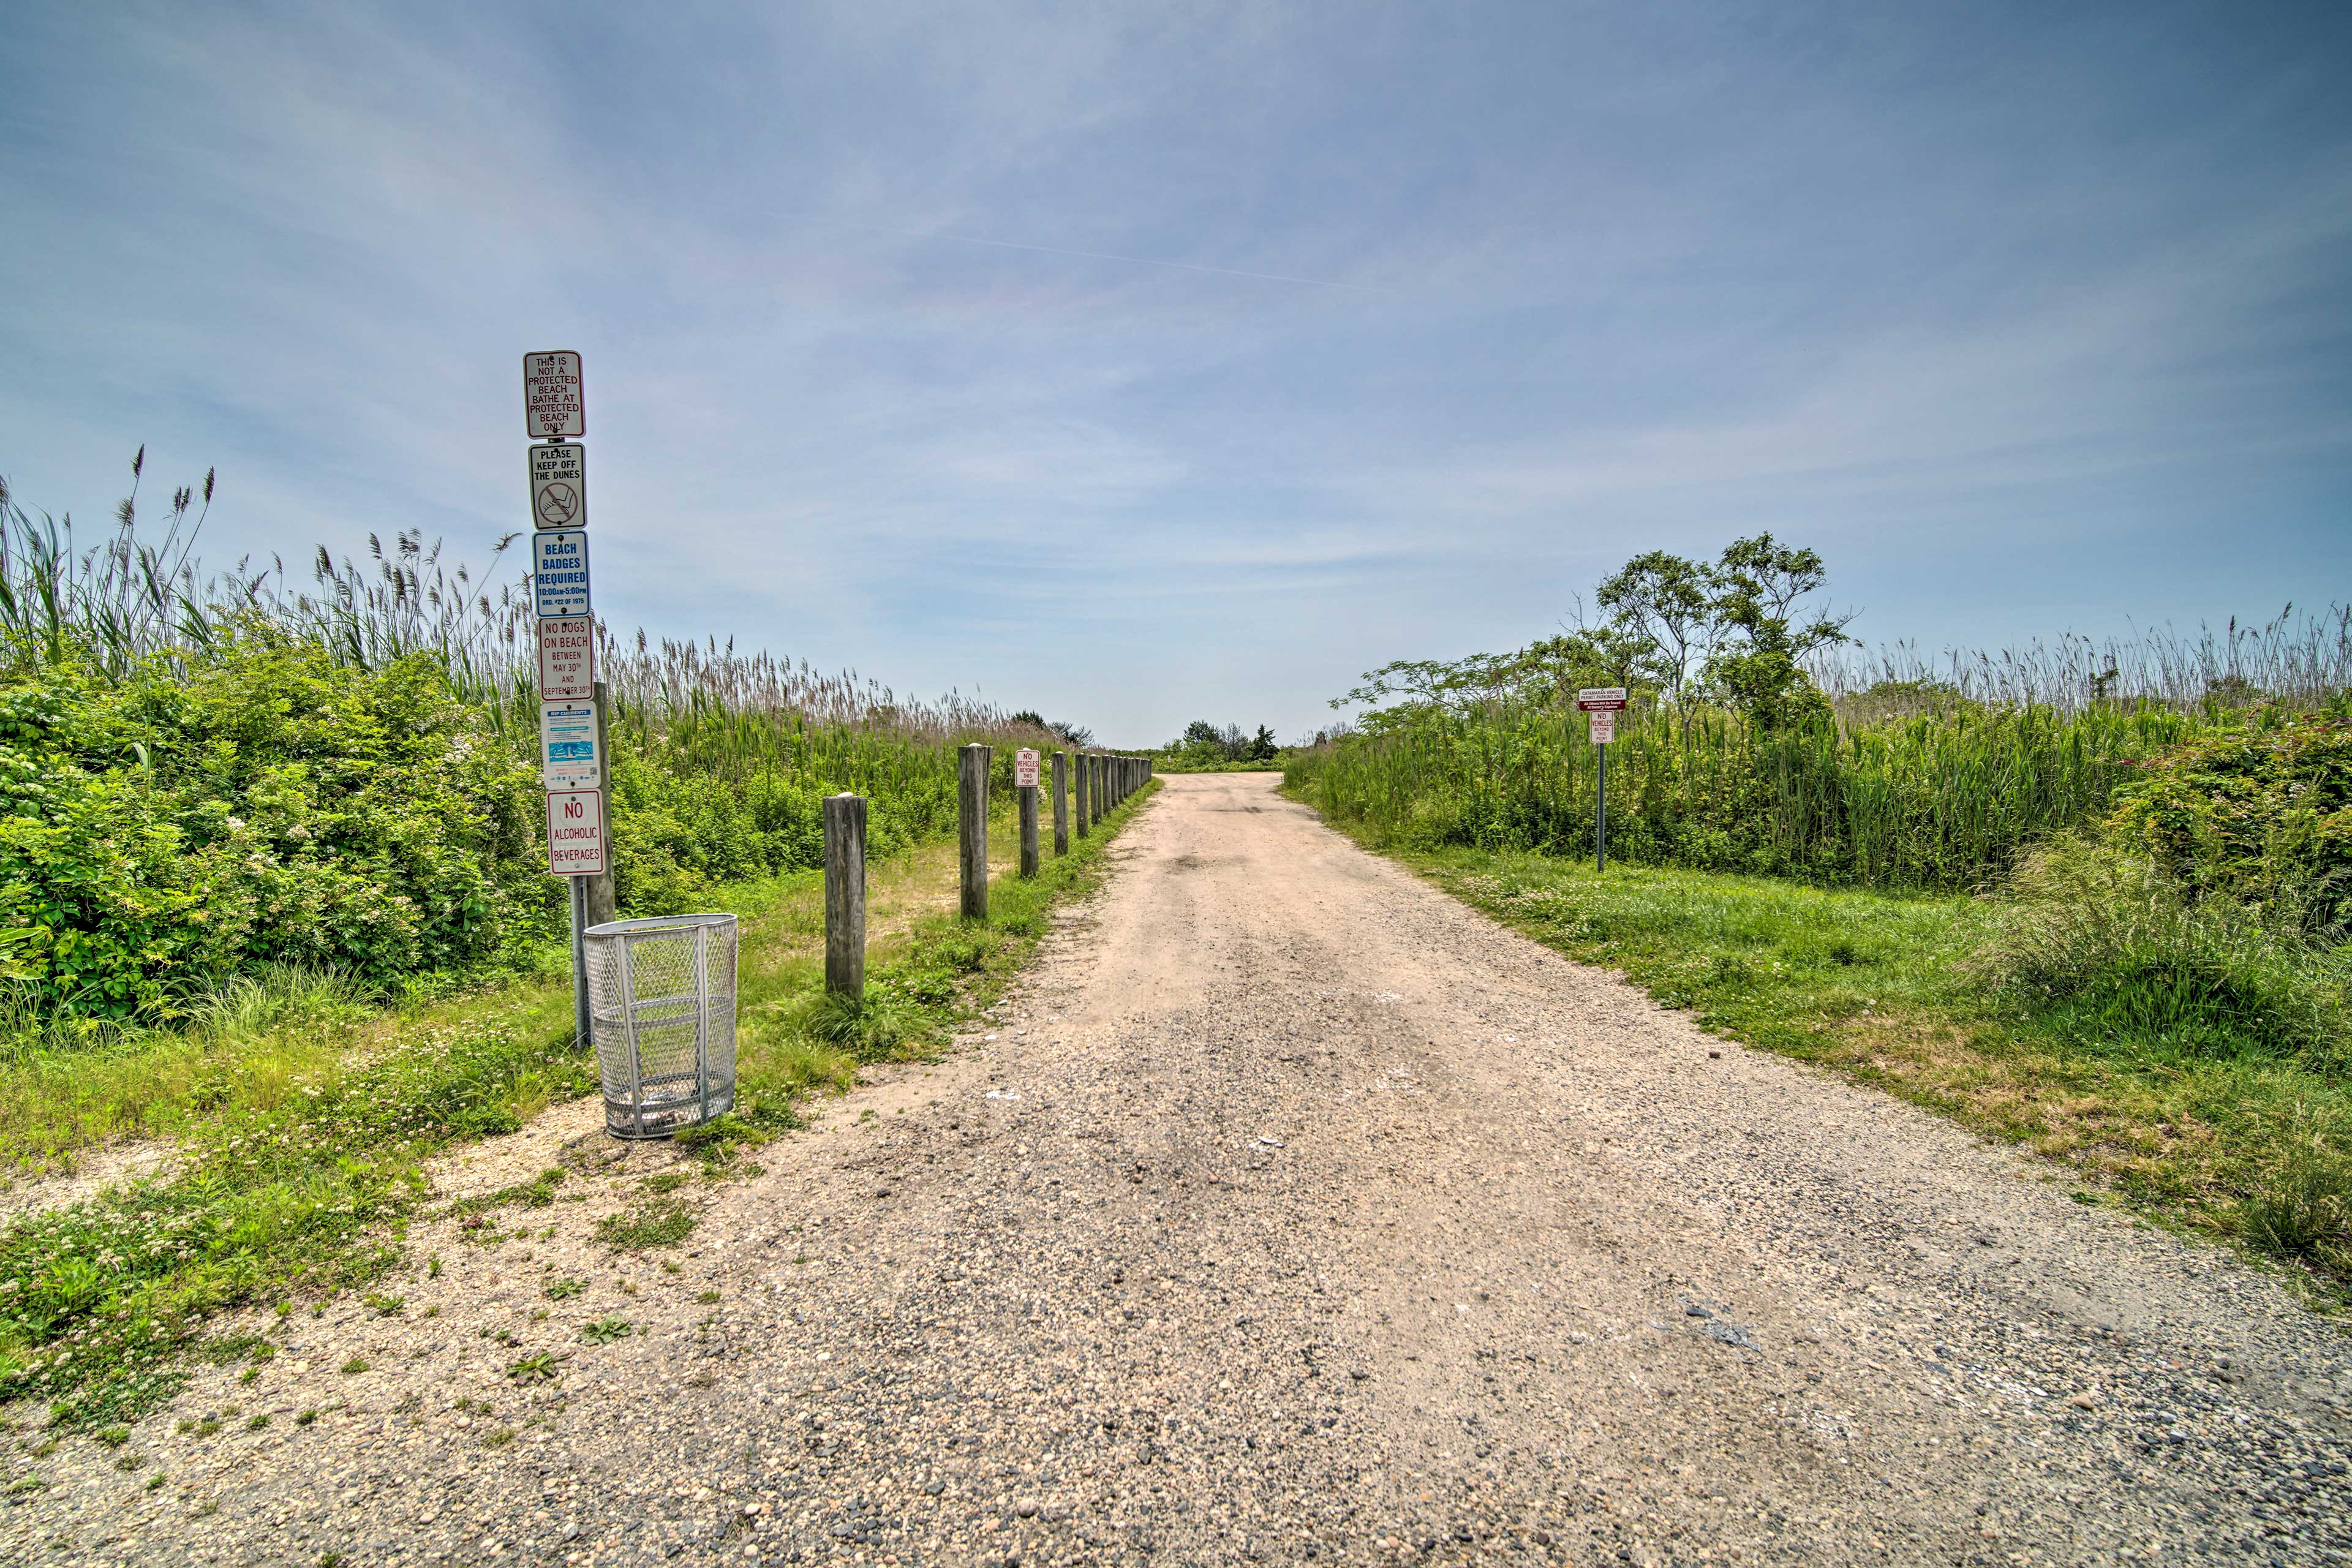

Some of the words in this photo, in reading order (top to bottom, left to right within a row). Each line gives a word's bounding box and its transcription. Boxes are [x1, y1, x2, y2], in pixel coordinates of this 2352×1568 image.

[536, 357, 555, 366] THIS
[538, 367, 554, 375] NOT
[529, 375, 578, 385] PROTECTED
[538, 385, 567, 394] BEACH
[533, 394, 559, 404] BATHE
[530, 404, 579, 413] PROTECTED
[540, 413, 568, 421] BEACH
[544, 422, 565, 431] ONLY
[541, 450, 571, 459] PLEASE
[537, 461, 557, 470] KEEP
[535, 472, 550, 480] THE
[553, 470, 579, 479] DUNES
[545, 543, 576, 555] BEACH
[543, 558, 580, 570] BADGES
[539, 572, 586, 586] REQUIRED
[546, 623, 558, 633] NO
[562, 622, 584, 633] DOGS
[545, 638, 556, 648] ON
[560, 636, 588, 647] BEACH
[552, 651, 581, 660] BETWEEN
[568, 663, 581, 672] 30TH
[565, 802, 582, 818] NO
[554, 827, 597, 840] ALCOHOLIC
[554, 848, 600, 861] BEVERAGES
